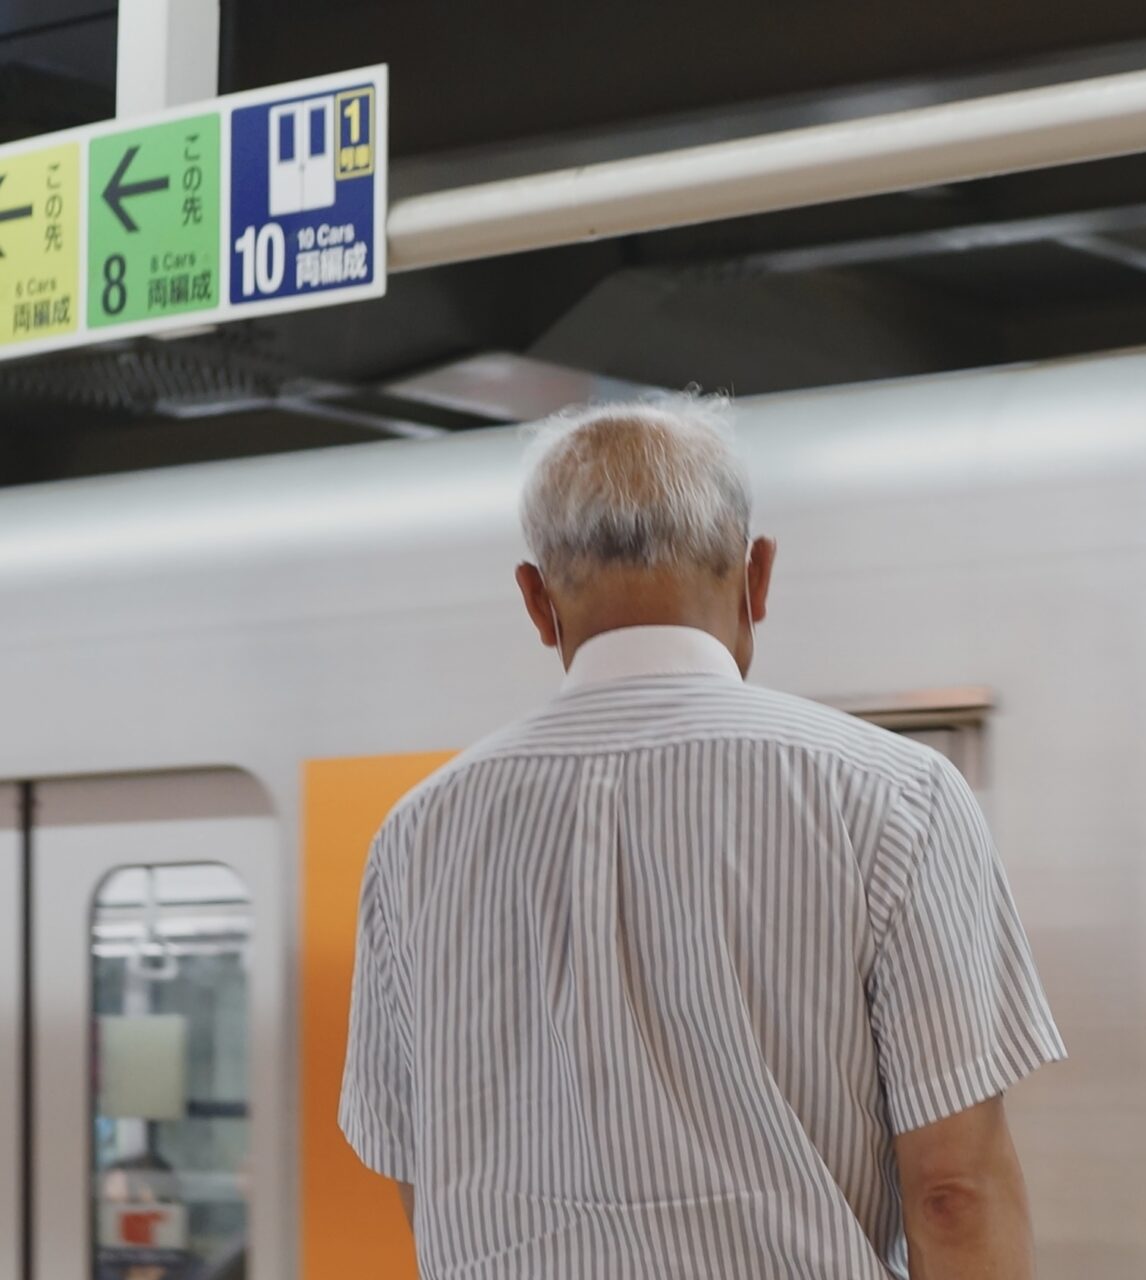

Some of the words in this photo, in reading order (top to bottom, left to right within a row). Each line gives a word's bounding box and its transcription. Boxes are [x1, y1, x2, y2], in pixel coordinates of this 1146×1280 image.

[343, 98, 360, 145] 1
[45, 162, 63, 254] この先
[182, 134, 203, 227] この先
[162, 251, 197, 271] Cars
[235, 222, 286, 297] 10
[297, 226, 315, 251] 10
[316, 223, 355, 248] Cars
[102, 253, 127, 316] 8
